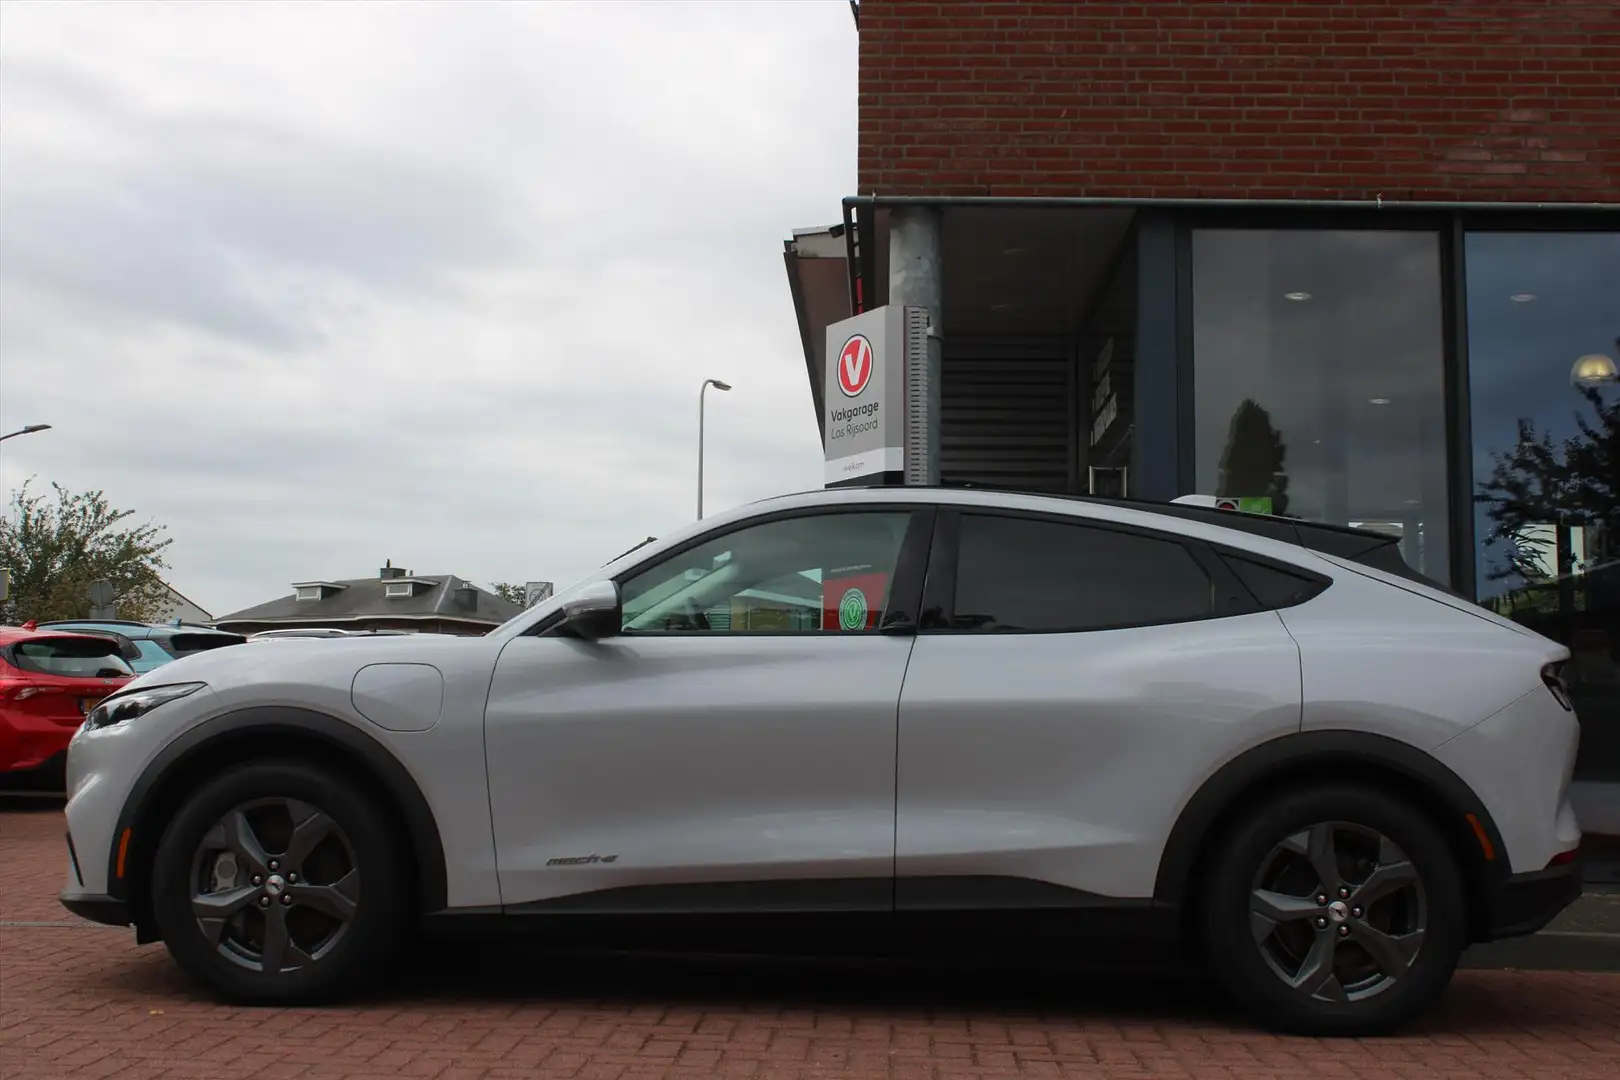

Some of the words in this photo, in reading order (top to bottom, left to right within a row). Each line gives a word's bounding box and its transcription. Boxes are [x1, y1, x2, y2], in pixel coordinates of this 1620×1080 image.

[845, 339, 867, 386] V
[831, 401, 879, 422] Vakgarage
[846, 418, 879, 438] Rijsoord
